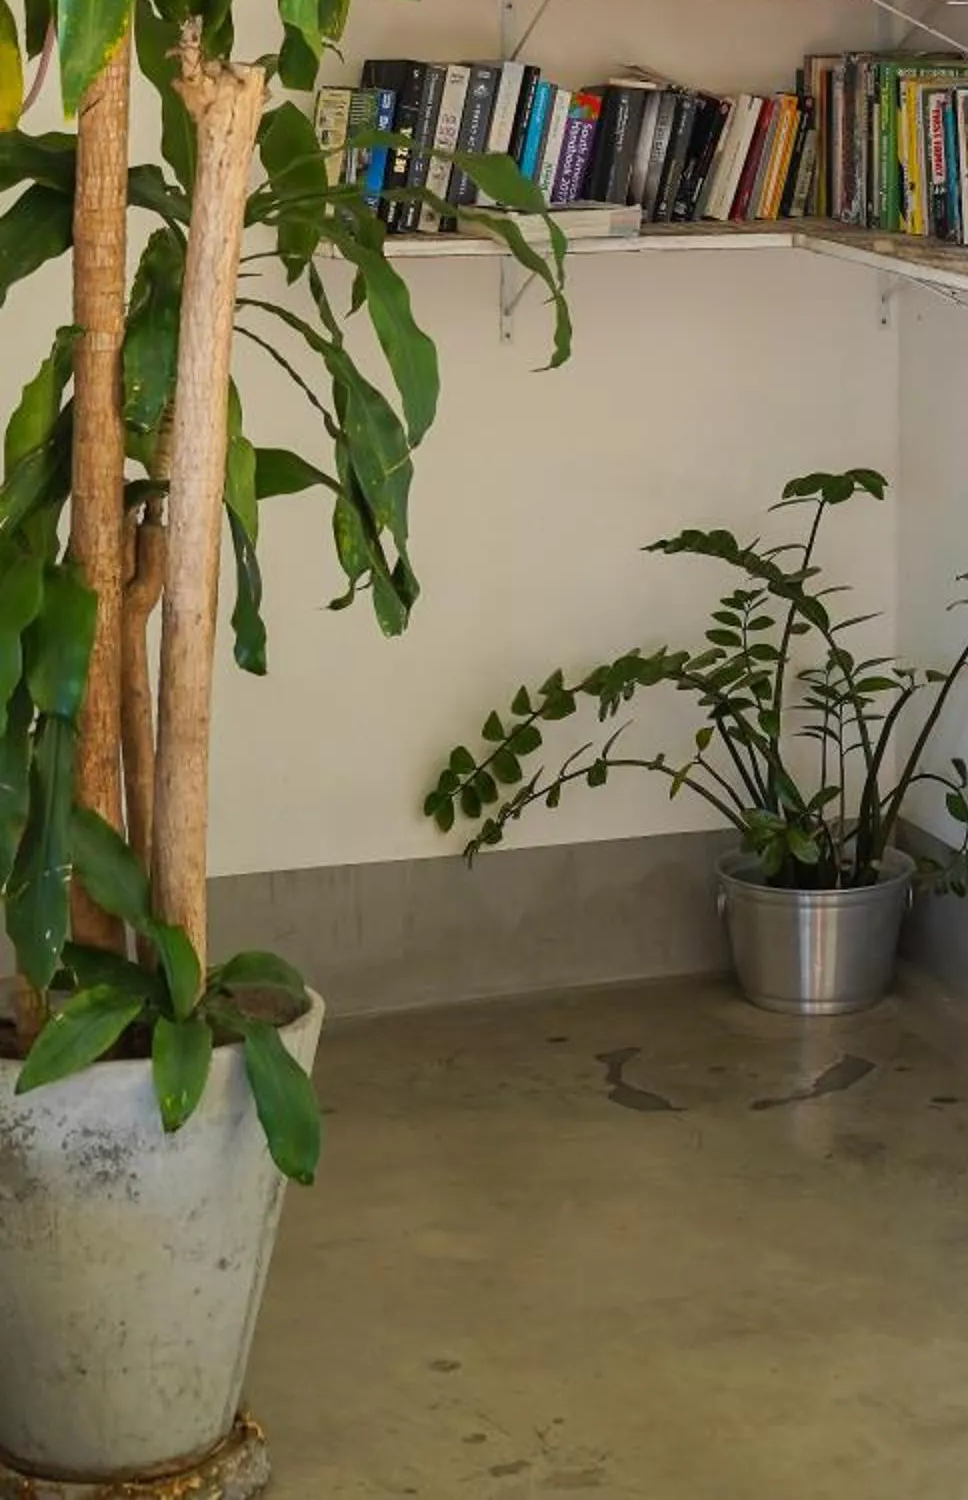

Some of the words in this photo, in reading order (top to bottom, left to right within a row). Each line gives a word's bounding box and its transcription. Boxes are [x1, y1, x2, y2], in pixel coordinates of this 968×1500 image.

[562, 121, 582, 175] Handbook
[577, 123, 593, 155] South
[568, 155, 585, 200] America
